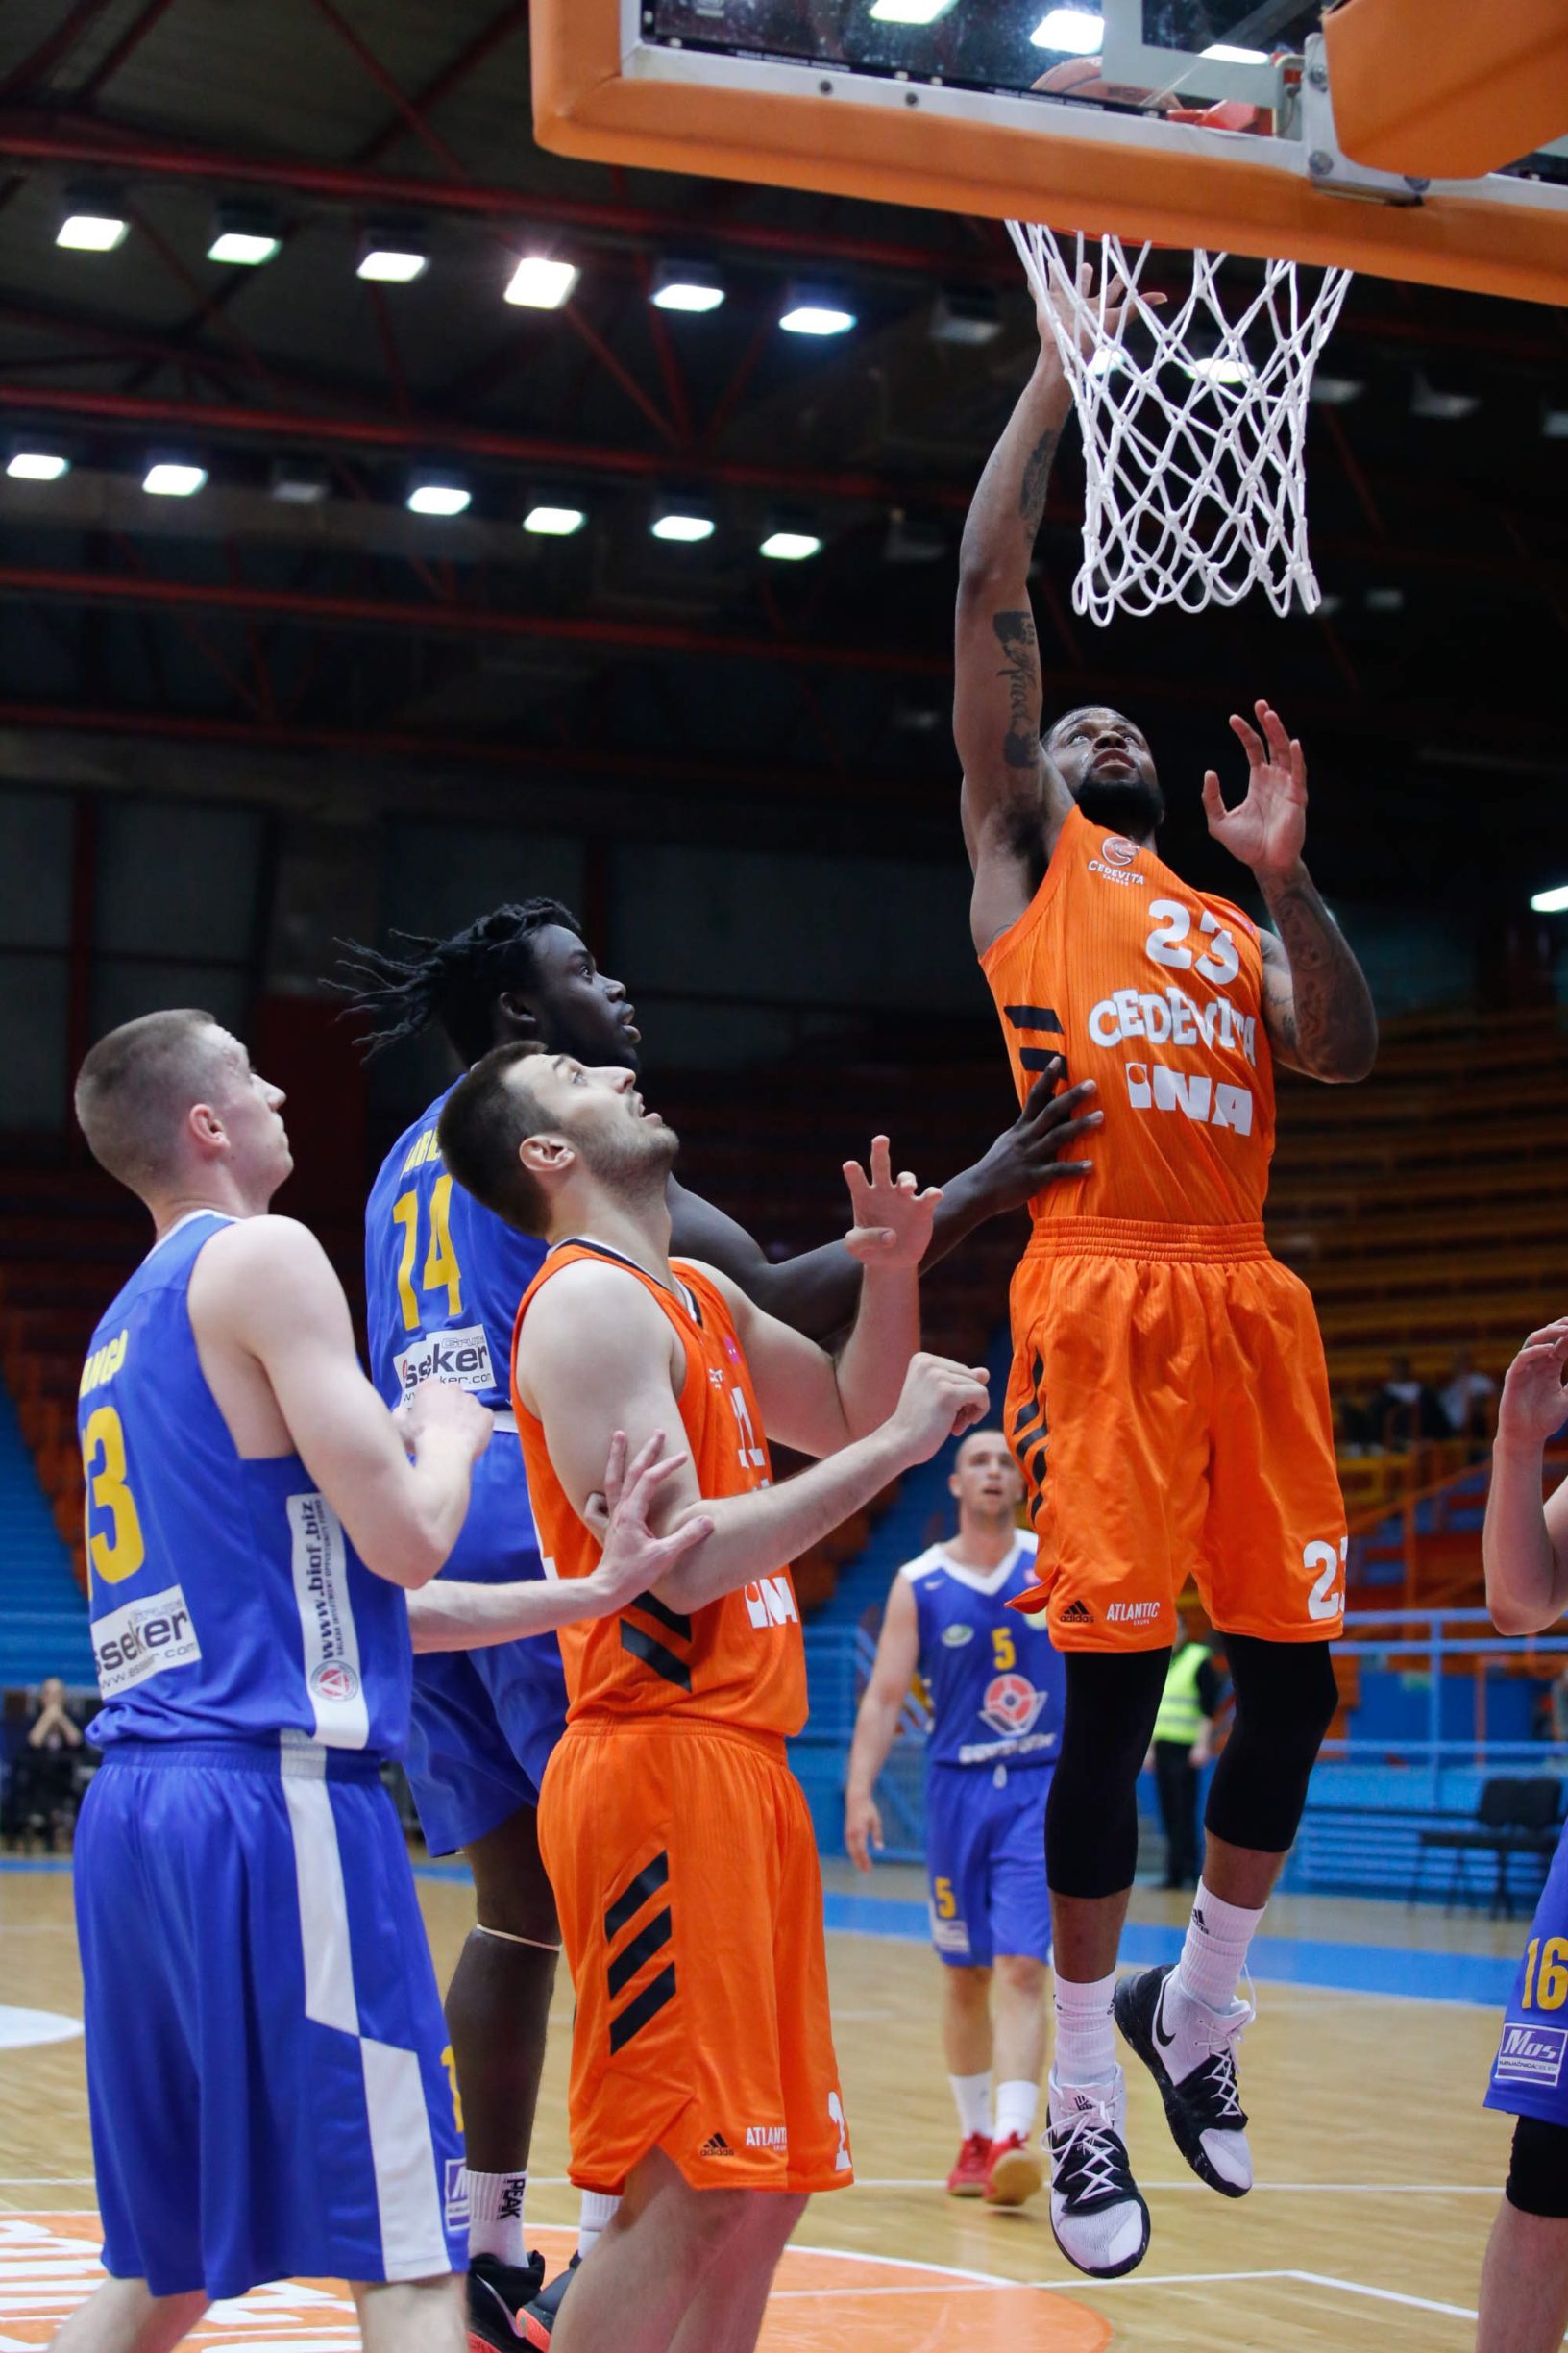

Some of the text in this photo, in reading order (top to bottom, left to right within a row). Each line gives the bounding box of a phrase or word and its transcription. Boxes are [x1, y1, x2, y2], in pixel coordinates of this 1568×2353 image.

[1088, 859, 1144, 885] CEDEVITA
[1145, 899, 1240, 985] 23
[393, 1174, 461, 1331] 14
[82, 1406, 145, 1602] 3
[1303, 1536, 1348, 1620] 2
[1060, 1613, 1095, 1623] adidas
[1106, 1602, 1161, 1621] ATLANTIC
[992, 1627, 1016, 1672] 5
[935, 1876, 956, 1919] 5
[1522, 1936, 1568, 2010] 16
[1503, 2028, 1561, 2060] Mos
[498, 2178, 526, 2220] PEAK
